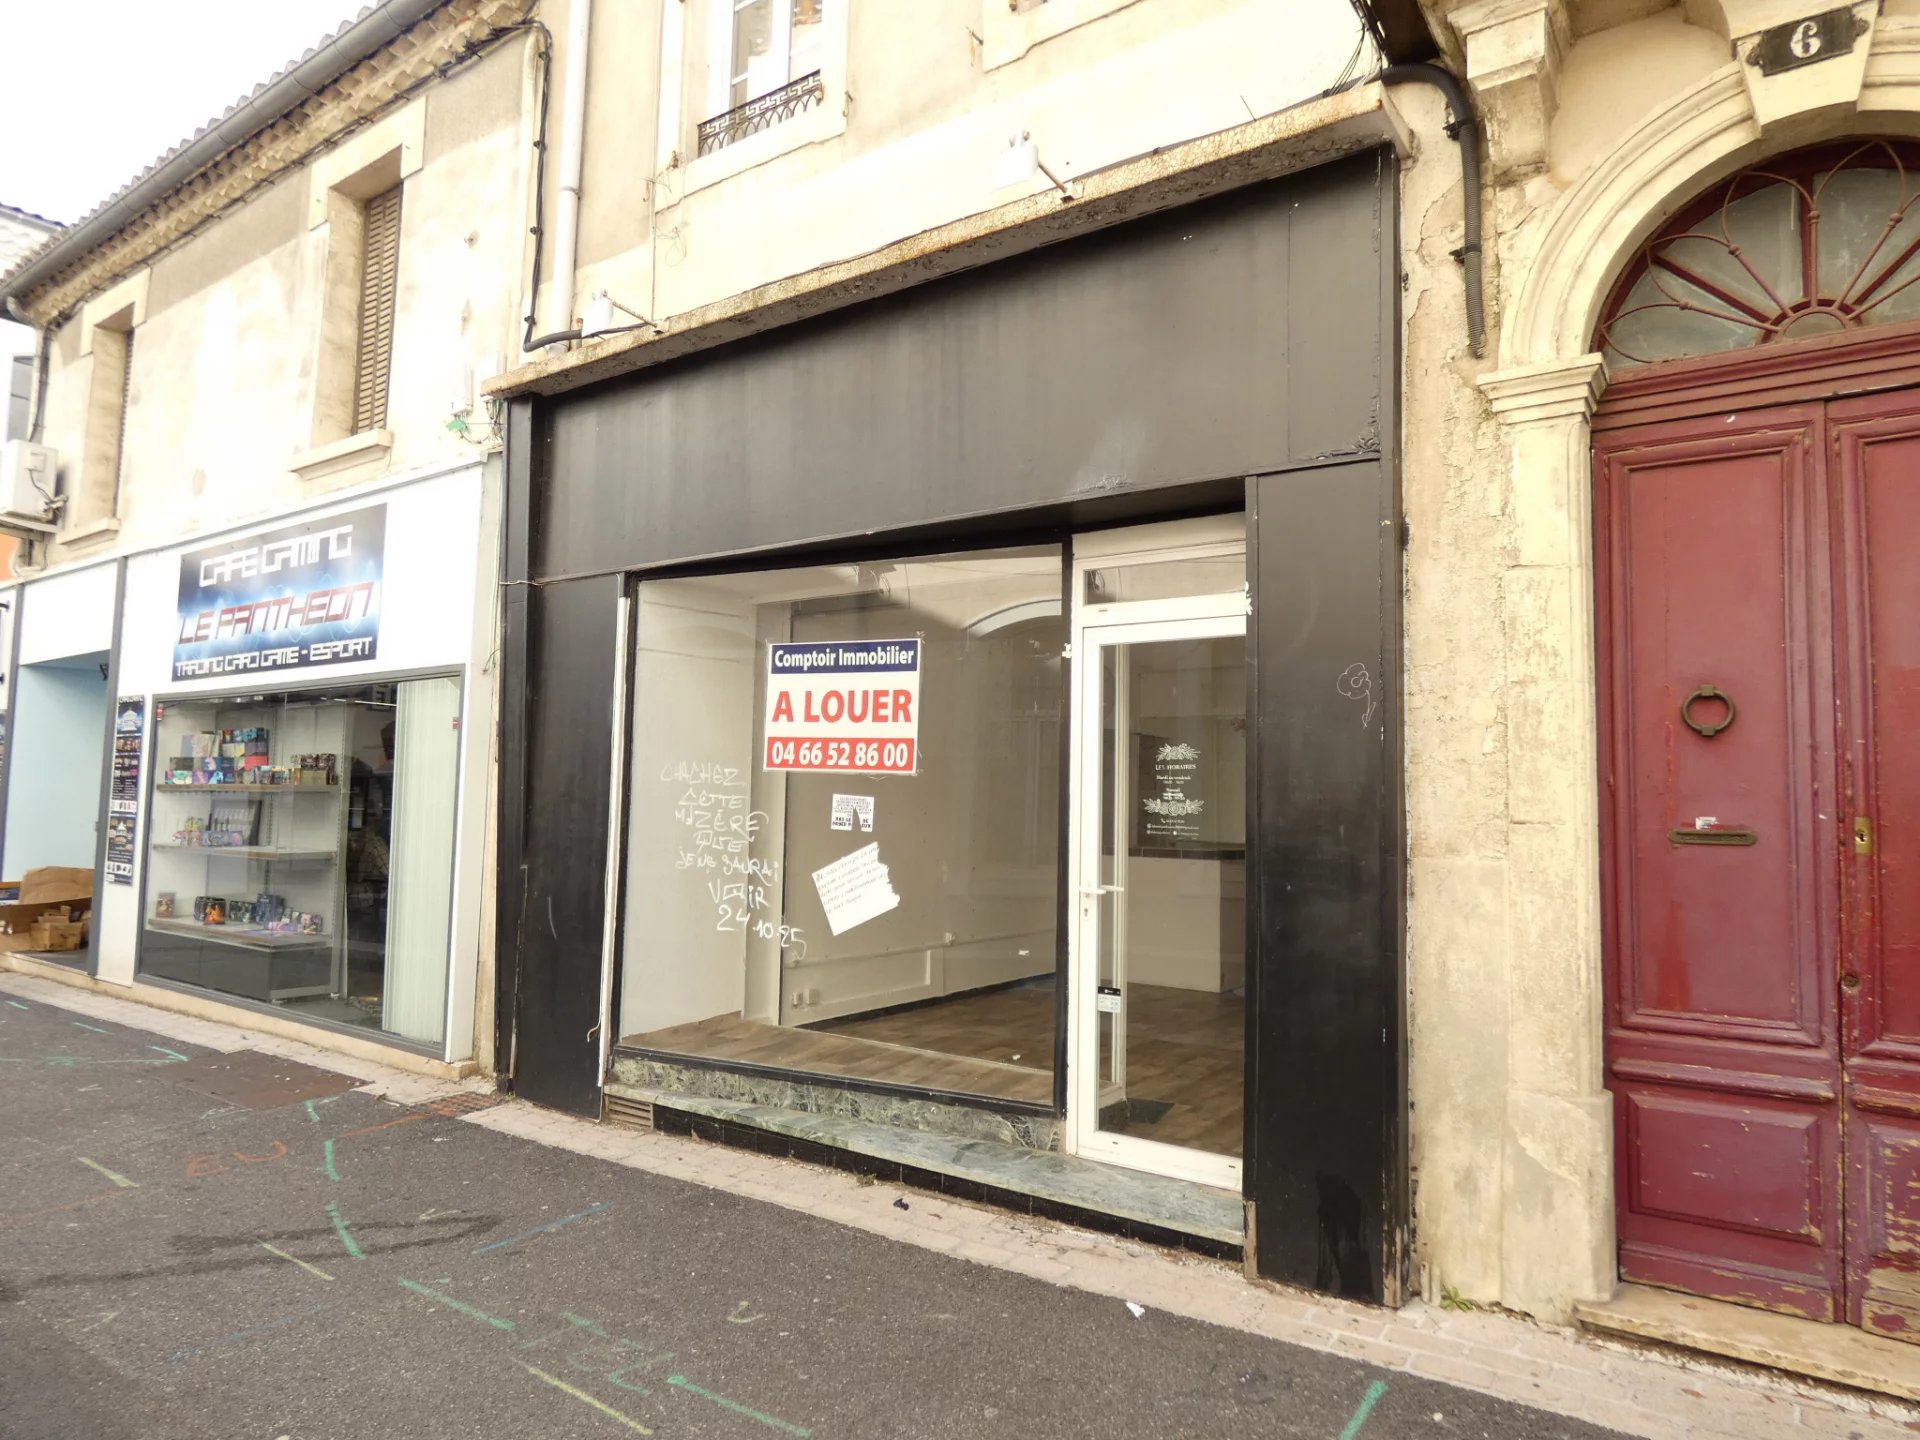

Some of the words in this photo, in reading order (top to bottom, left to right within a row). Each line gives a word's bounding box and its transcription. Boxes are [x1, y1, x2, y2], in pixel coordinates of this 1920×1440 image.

[1790, 21, 1821, 58] 6
[200, 547, 261, 587] CAFE
[261, 524, 354, 575] GAMING
[178, 610, 215, 645] LE
[214, 581, 375, 640] PANTHEON
[224, 651, 260, 671] CARD
[260, 646, 300, 667] GAME
[309, 636, 373, 662] ESPORT
[774, 648, 836, 671] Comptoir
[838, 645, 915, 666] Immobilier
[771, 690, 795, 723] A
[803, 689, 913, 724] LOUER
[771, 741, 795, 765] 04
[799, 741, 823, 766] 66
[826, 742, 850, 766] 52
[854, 742, 879, 767] 86
[883, 742, 908, 768] 00
